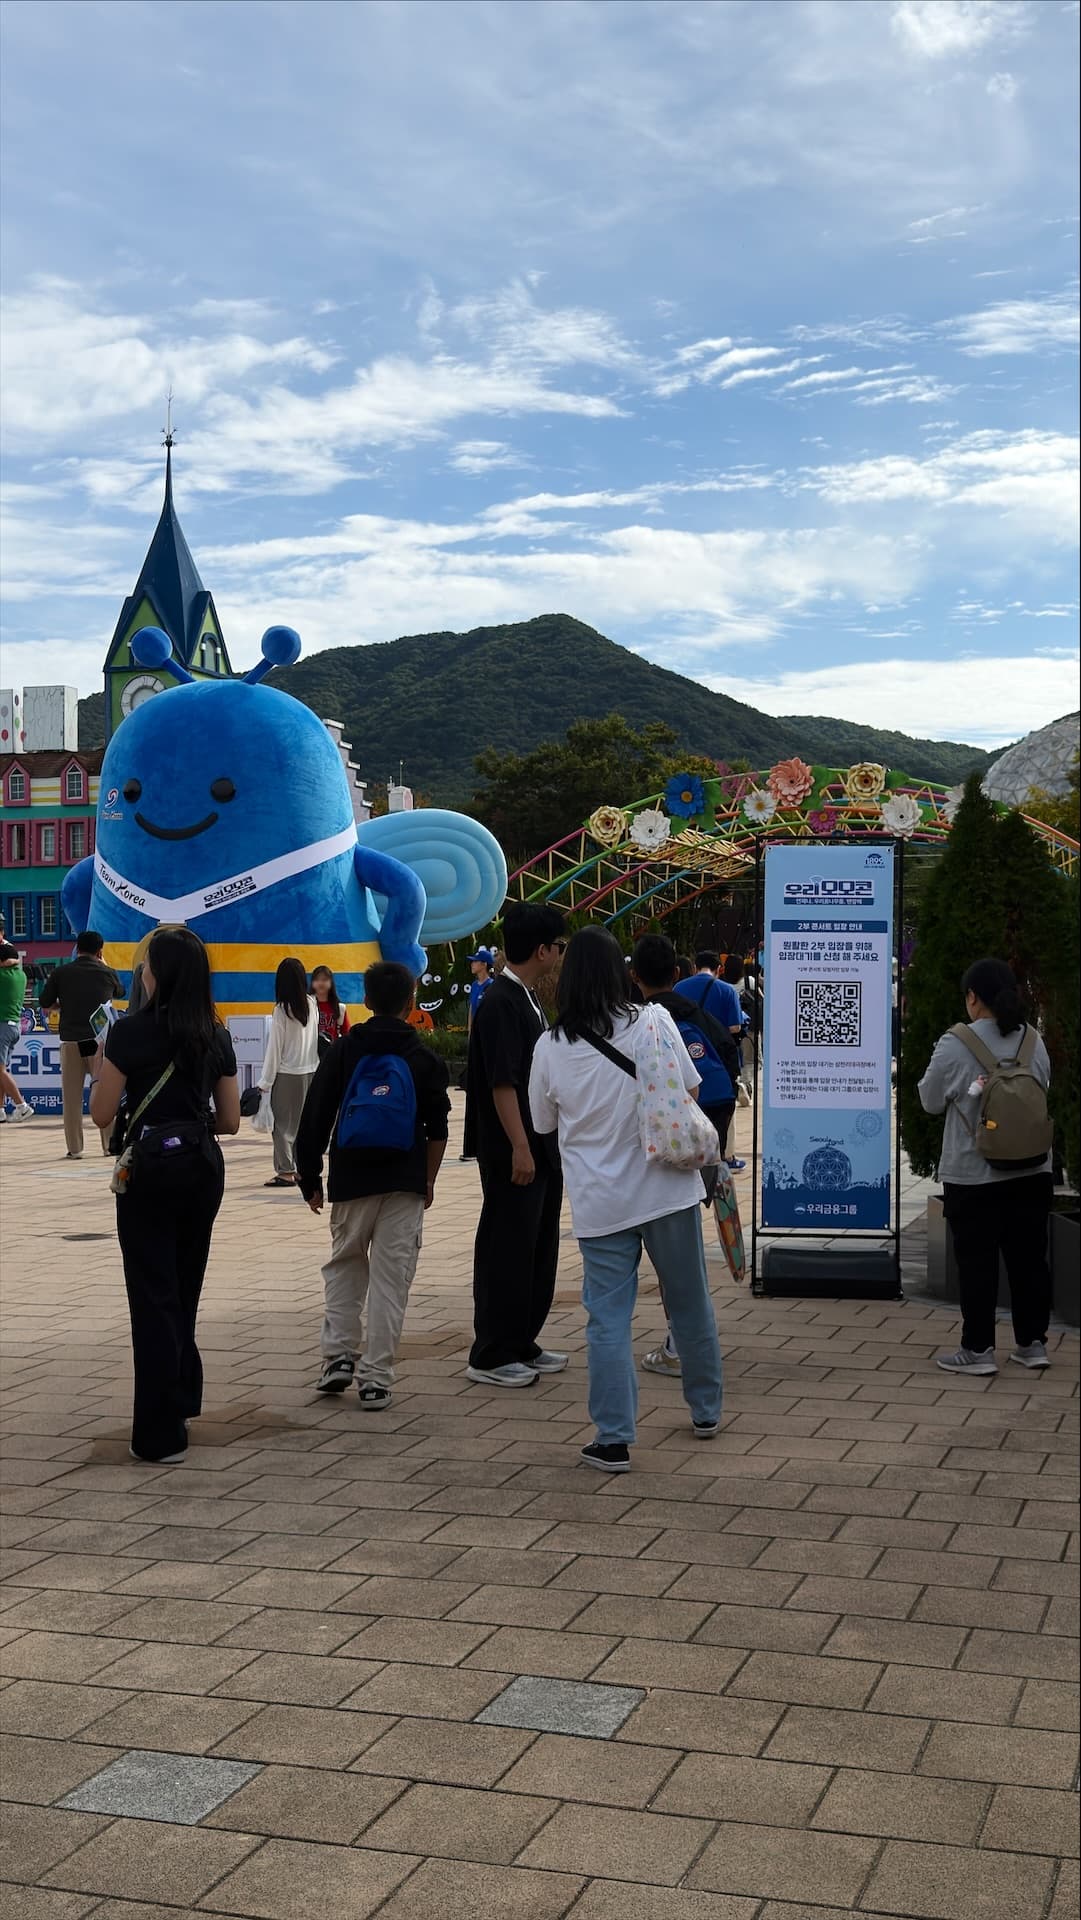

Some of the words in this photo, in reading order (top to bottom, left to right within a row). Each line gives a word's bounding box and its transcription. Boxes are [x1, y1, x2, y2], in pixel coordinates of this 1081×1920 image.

[100, 863, 116, 889] Team
[116, 881, 146, 907] Korea
[785, 880, 872, 896] 우리모모콘
[798, 922, 810, 931] 2부
[811, 922, 832, 931] 콘서트
[833, 923, 848, 931] 입장
[848, 923, 863, 931] 안내
[783, 941, 809, 951] 원활한
[810, 941, 826, 951] 2부
[827, 941, 853, 951] 입장을
[855, 941, 873, 951] 위해
[779, 951, 821, 961] 입장대기를
[823, 952, 840, 962] 신청
[842, 952, 851, 962] 해
[852, 952, 879, 962] 주세요
[806, 1203, 857, 1215] 우리금융그룹
